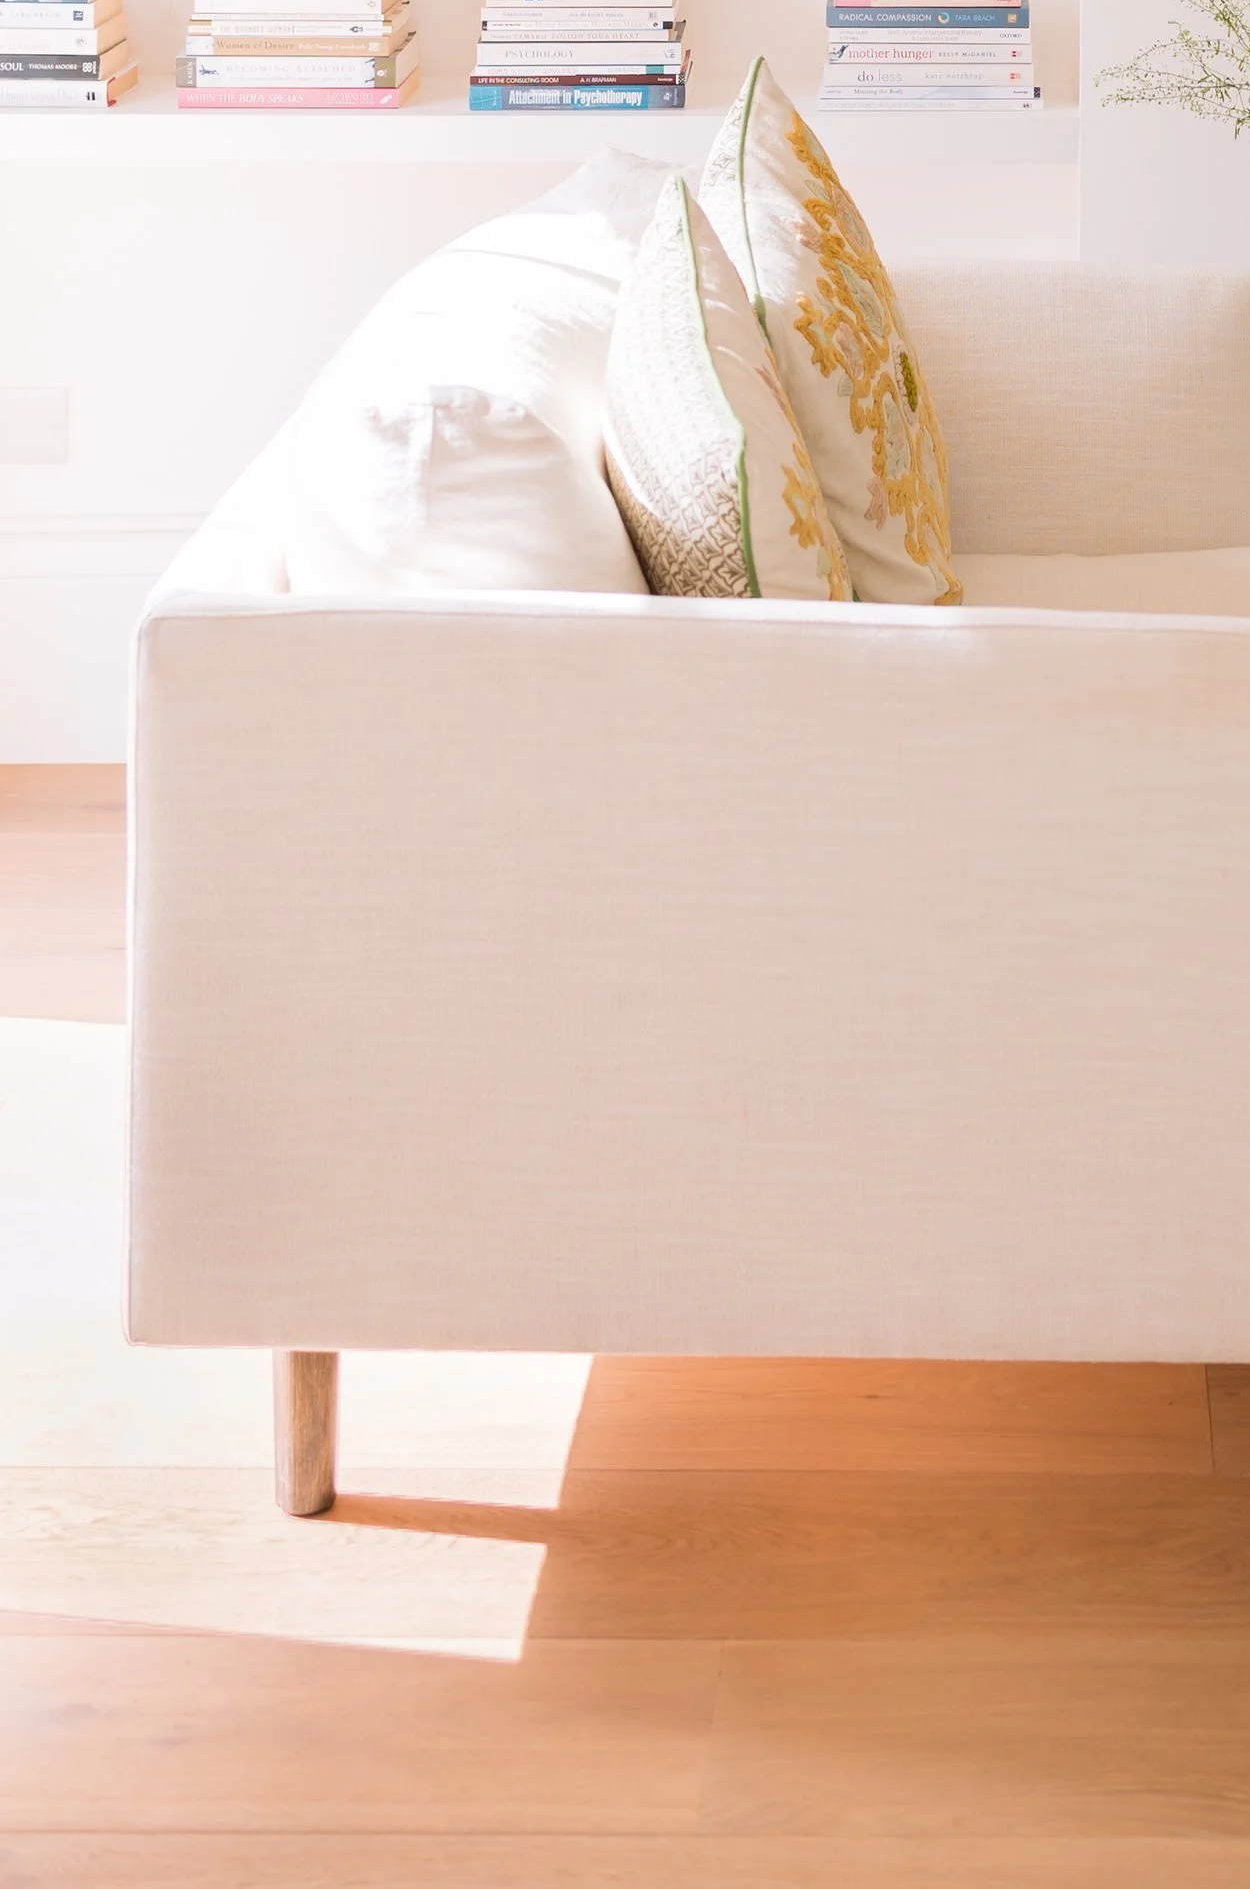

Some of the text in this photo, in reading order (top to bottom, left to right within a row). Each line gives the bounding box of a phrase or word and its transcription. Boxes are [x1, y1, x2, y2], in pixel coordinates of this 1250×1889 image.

[838, 13, 932, 22] RADICAL COMPASSION
[955, 13, 996, 22] TARA BRACH
[216, 41, 251, 49] Women
[264, 41, 295, 49] Desire
[505, 50, 575, 59] PSYCHOLOGY
[848, 44, 934, 61] mother hunger
[0, 62, 24, 72] SOUL
[28, 62, 78, 70] THOMAS MOORE
[296, 64, 356, 73] ATTACHED
[857, 69, 903, 82] do less
[186, 94, 304, 104] WHEN THE BODY SPEAKS
[508, 89, 643, 107] Attachment in Psychotherapy
